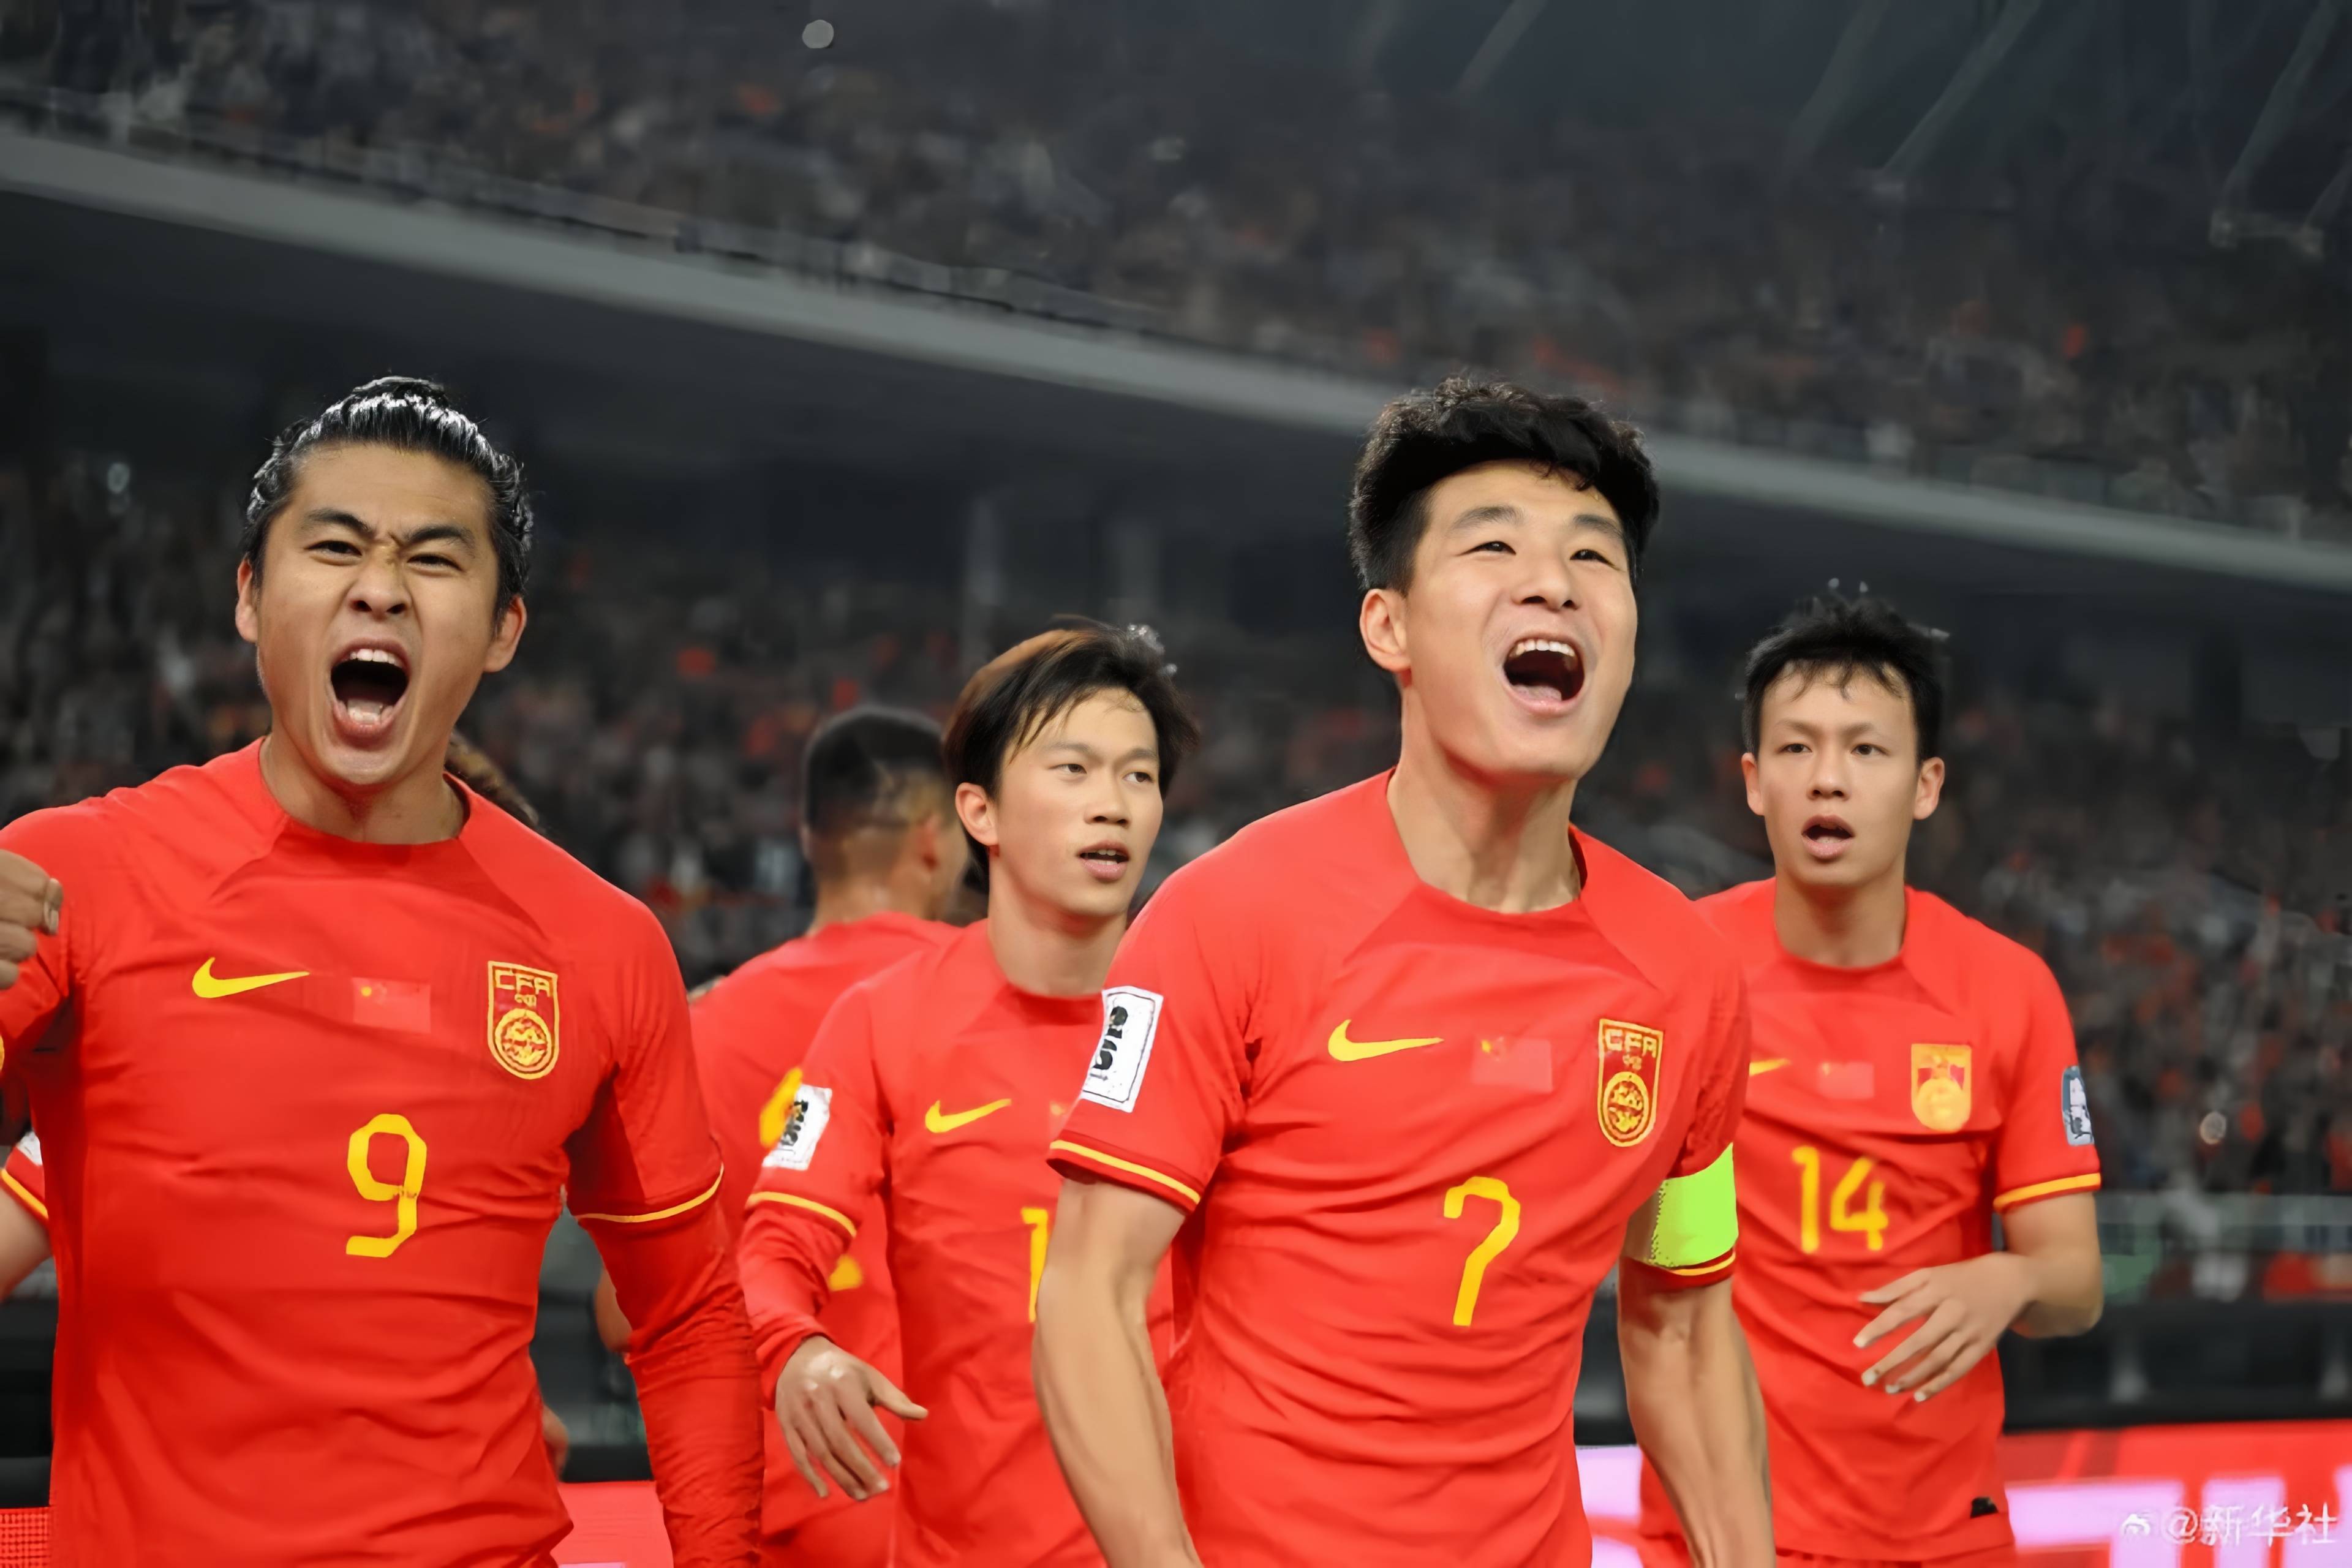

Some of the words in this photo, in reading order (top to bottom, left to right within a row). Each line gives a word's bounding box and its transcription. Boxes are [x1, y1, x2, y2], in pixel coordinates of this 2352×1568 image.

[346, 1113, 427, 1258] 9
[1444, 1176, 1520, 1326] 7
[1792, 1145, 1888, 1254] 14
